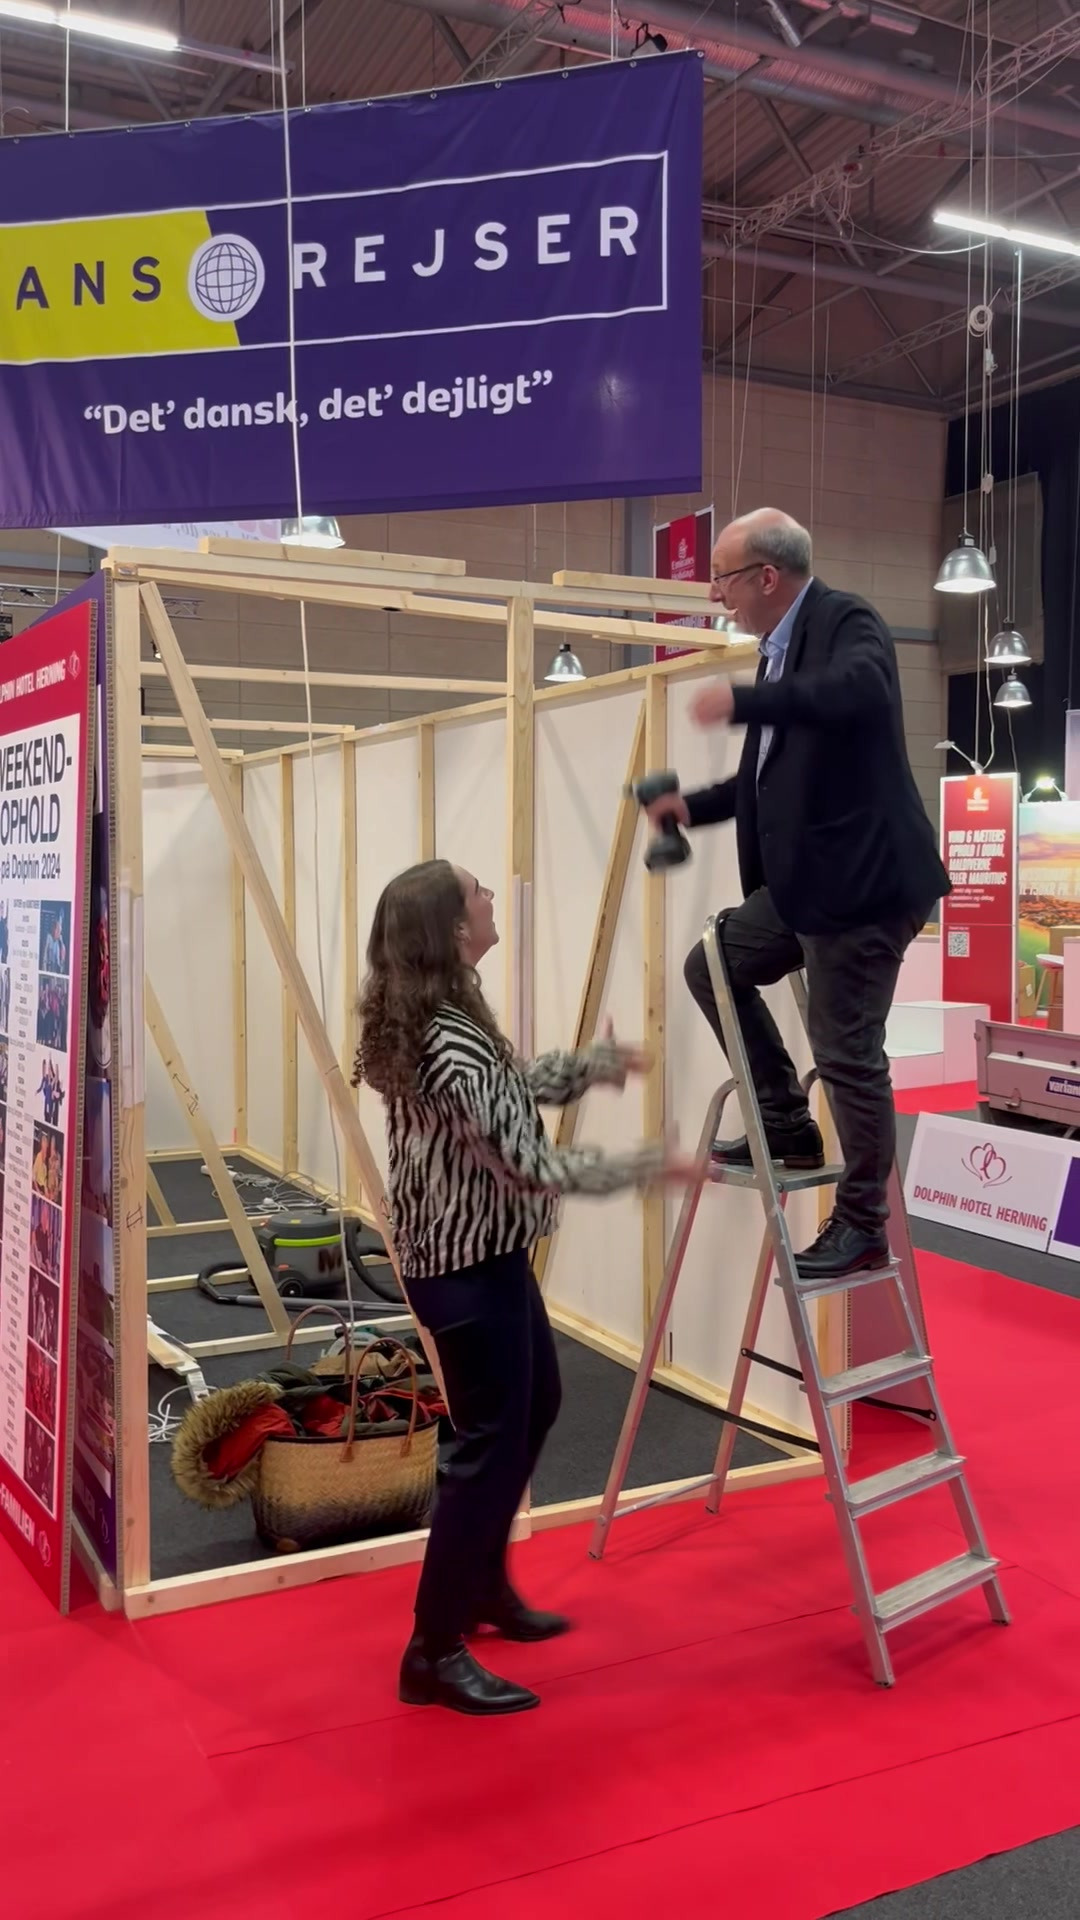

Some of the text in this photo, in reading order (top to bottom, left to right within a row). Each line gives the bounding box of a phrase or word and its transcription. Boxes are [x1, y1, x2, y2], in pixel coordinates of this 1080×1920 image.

[293, 206, 639, 289] REJSER
[84, 369, 553, 434] “Det’ dansk, det’ dejligt”
[1, 793, 61, 846] OPHOLD
[11, 853, 40, 884] Dolphin
[41, 852, 61, 880] 2024
[913, 1185, 1048, 1232] DOLPHIN HOTEL HERNING
